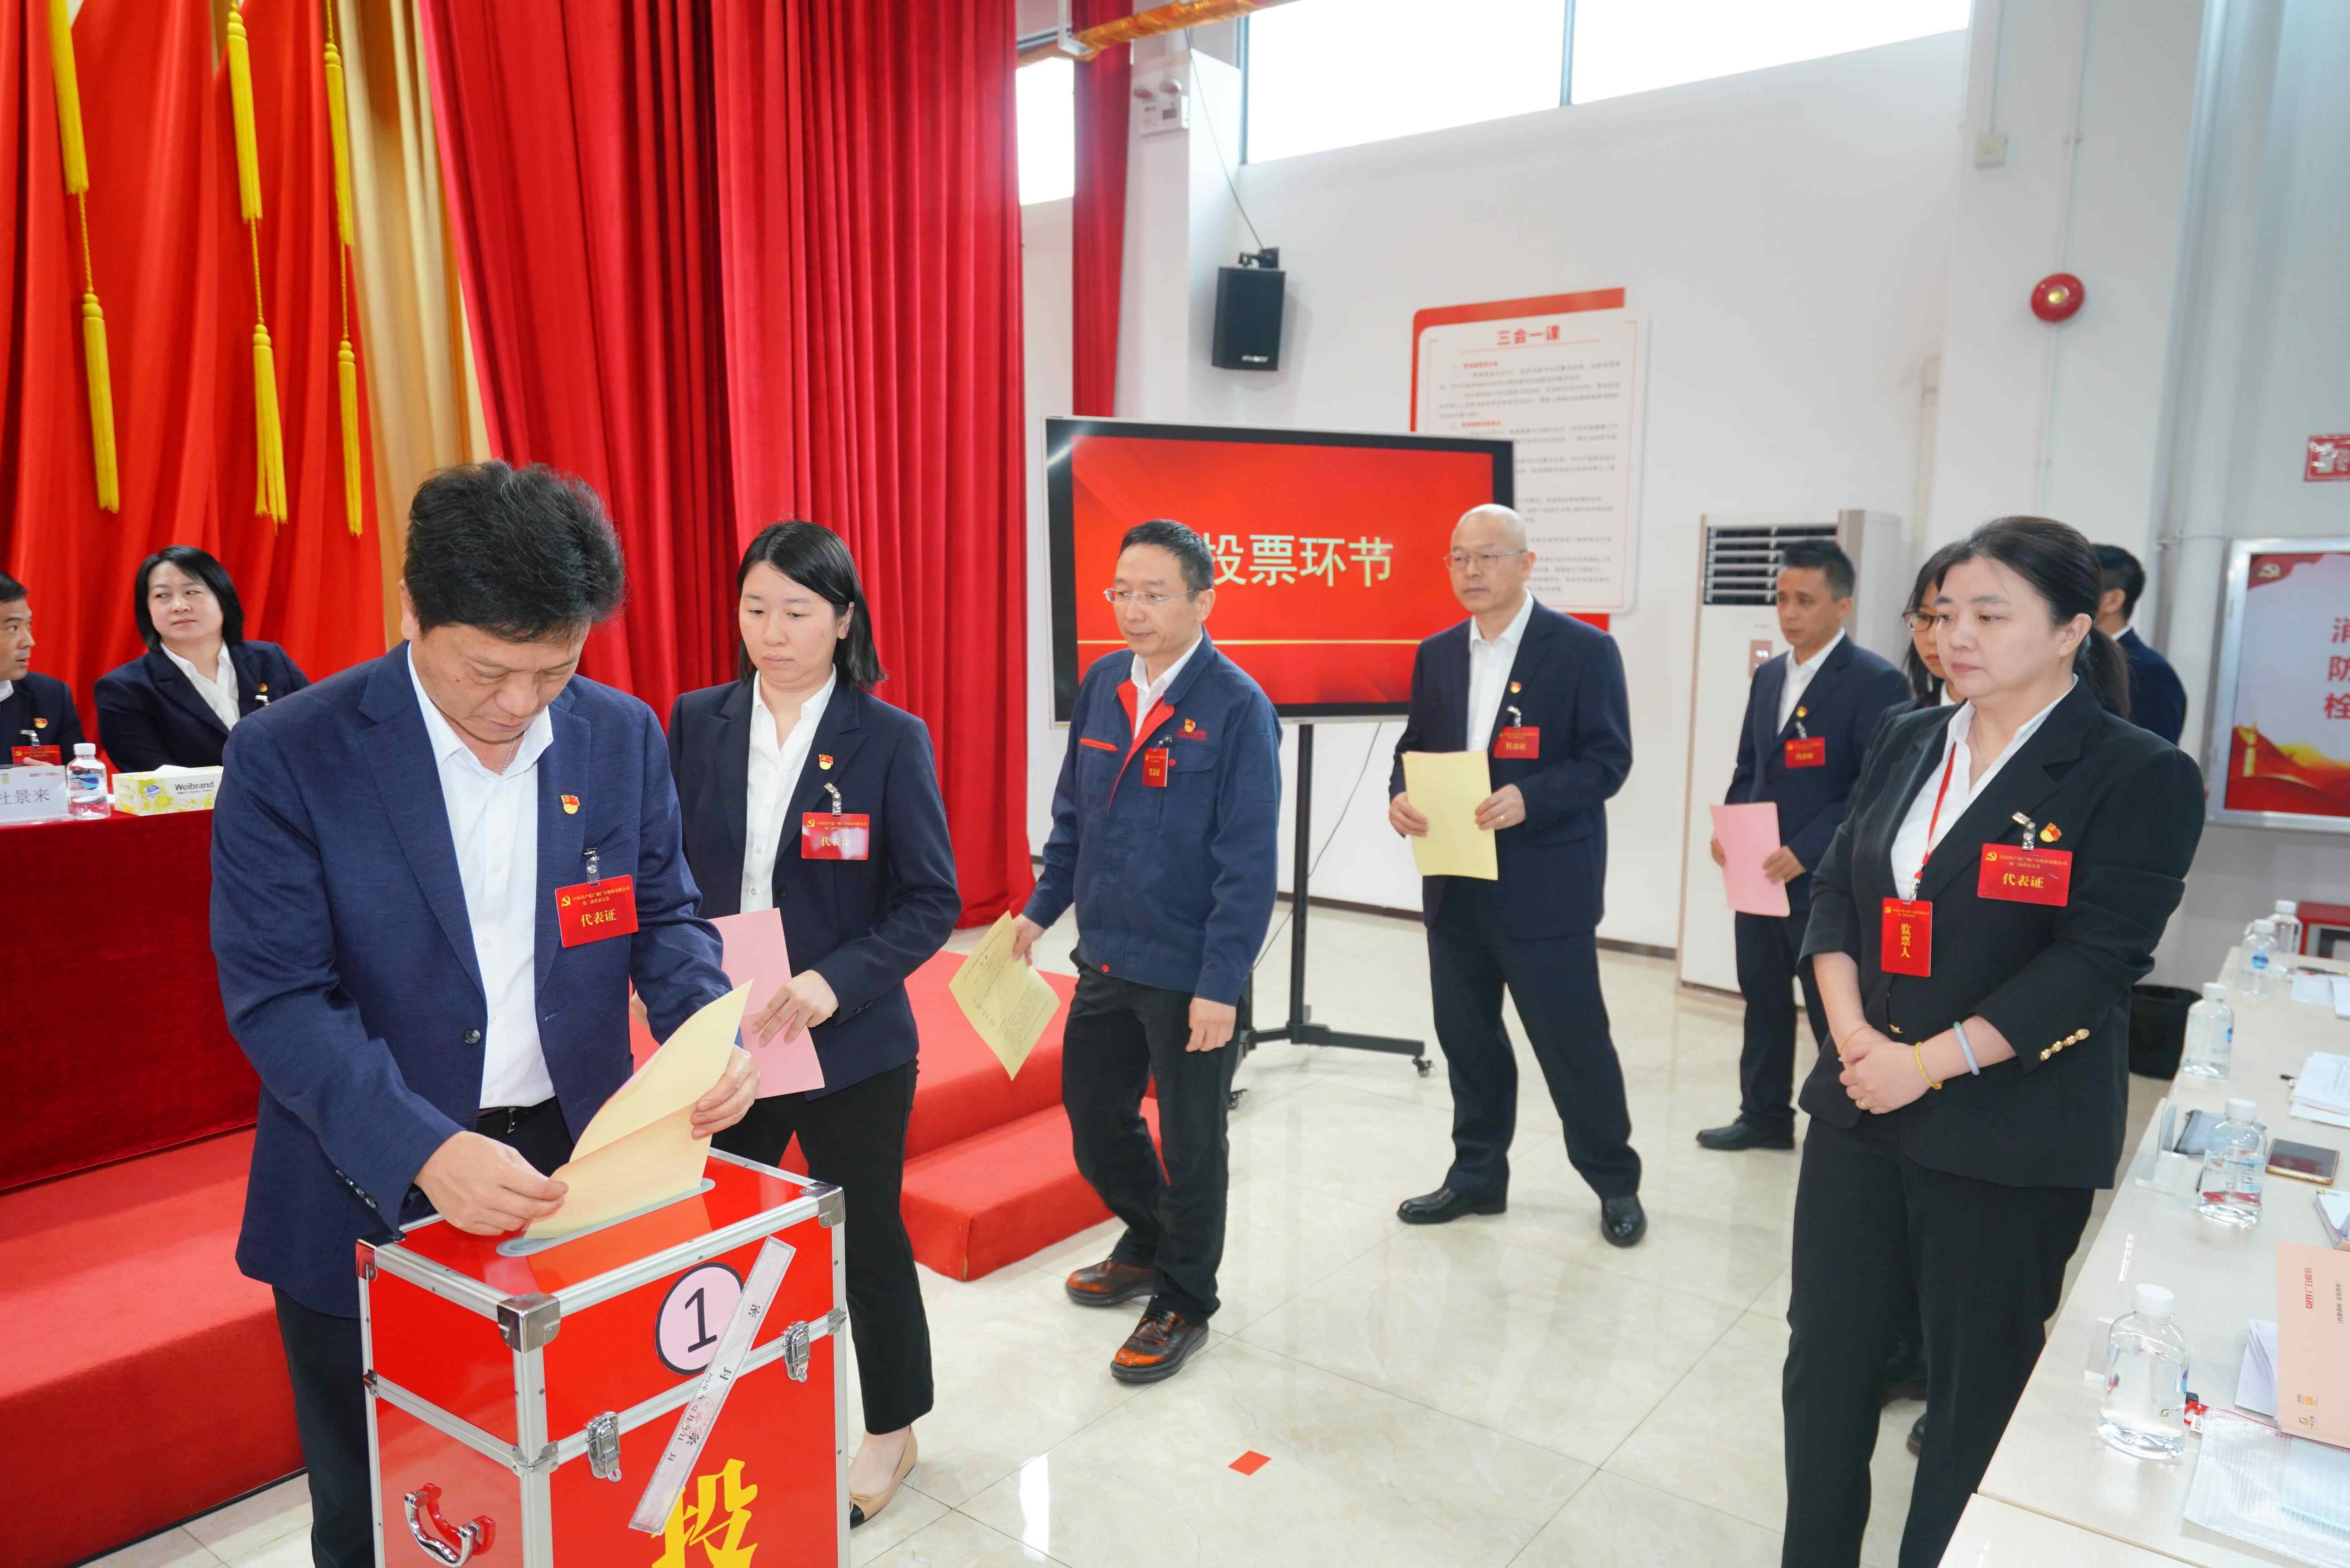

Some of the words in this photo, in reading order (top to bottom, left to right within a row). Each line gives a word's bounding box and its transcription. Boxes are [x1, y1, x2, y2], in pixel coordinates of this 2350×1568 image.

[1497, 325, 1560, 345] 三会一课
[1203, 532, 1393, 587] 投票环节
[175, 781, 214, 791] Weibrand
[821, 836, 852, 847] 代表证
[2002, 873, 2045, 889] 代表证
[581, 909, 618, 927] 代表证
[1900, 923, 1911, 958] 监票人
[684, 1287, 718, 1353] 1
[651, 1458, 758, 1568] 投
